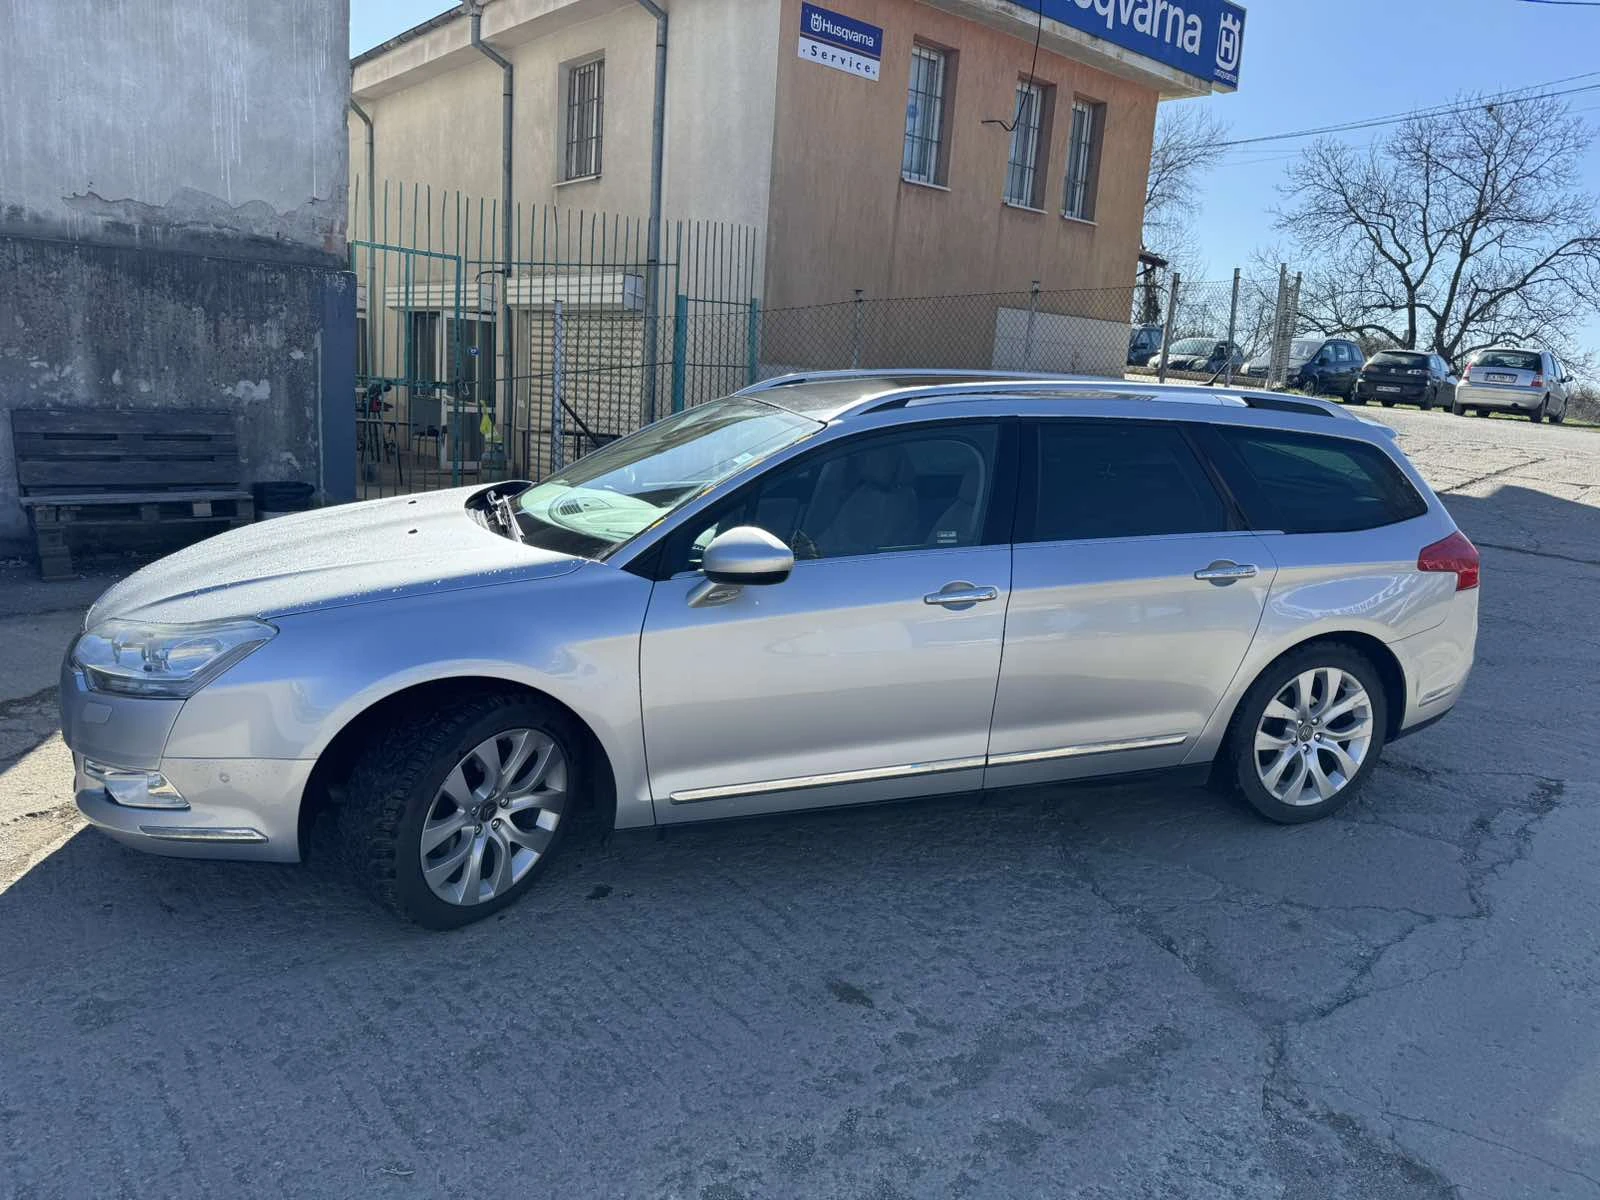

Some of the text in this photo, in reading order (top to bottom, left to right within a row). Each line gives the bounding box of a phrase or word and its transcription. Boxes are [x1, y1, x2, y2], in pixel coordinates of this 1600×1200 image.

[822, 18, 874, 47] Husqvarna
[1073, 0, 1202, 56] qvarna
[810, 44, 871, 73] Service
